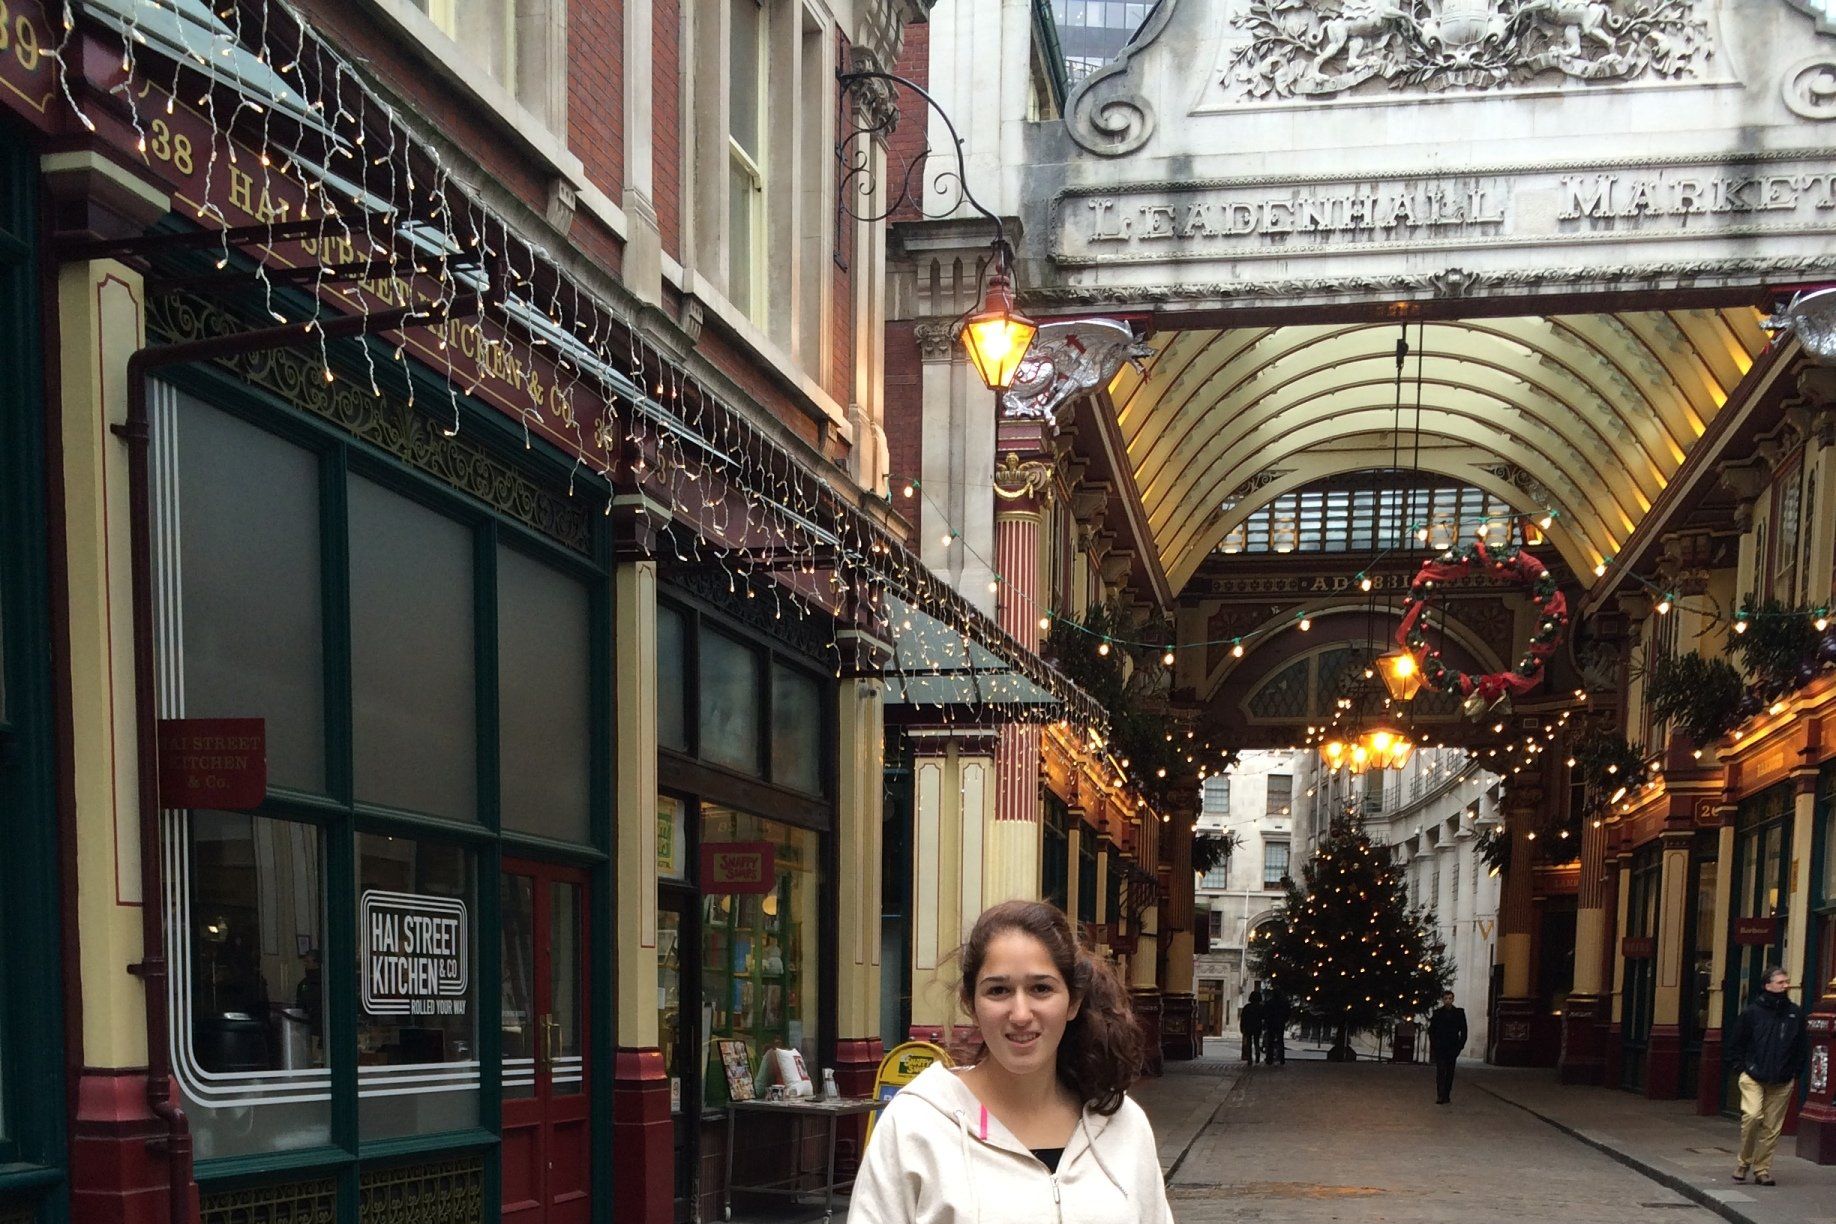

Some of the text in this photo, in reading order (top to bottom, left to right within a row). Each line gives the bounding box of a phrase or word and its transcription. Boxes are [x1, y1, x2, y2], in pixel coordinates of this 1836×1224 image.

[1087, 171, 1836, 243] LEADENHALL MARKET
[152, 119, 193, 174] 38
[529, 371, 544, 405] &
[1310, 576, 1349, 591] AD
[193, 736, 261, 750] STREET
[187, 775, 200, 788] &
[372, 912, 459, 956] HAI STREET
[372, 955, 458, 995] KITCHEN & CO
[411, 999, 467, 1015] ROLLED YOUR WAY
